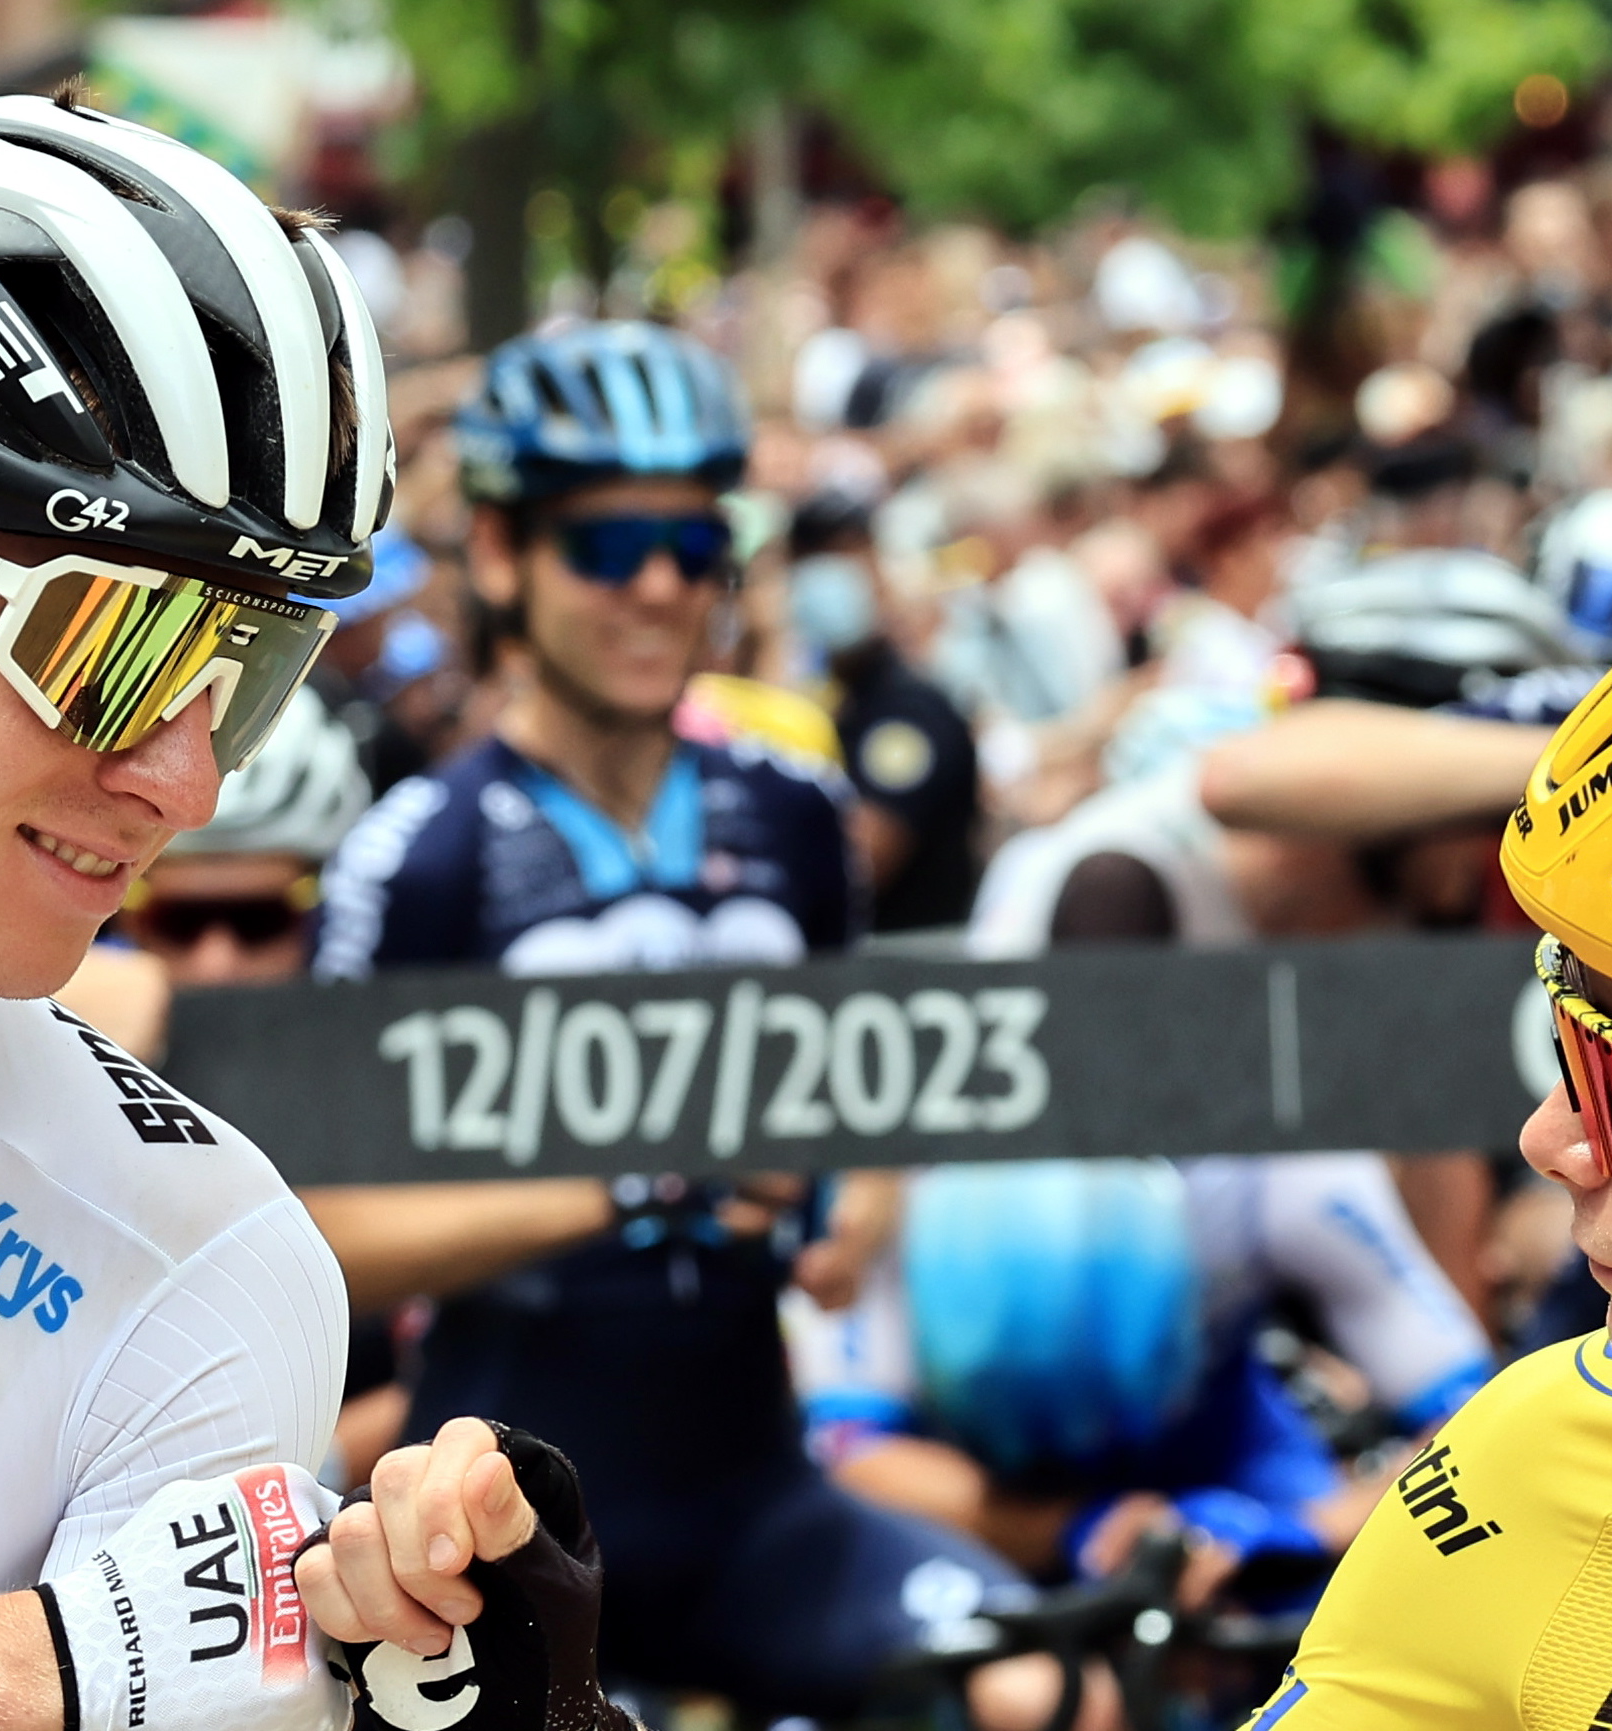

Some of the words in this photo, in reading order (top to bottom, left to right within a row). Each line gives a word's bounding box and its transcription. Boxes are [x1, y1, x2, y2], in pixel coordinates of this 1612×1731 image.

[45, 488, 132, 532] G42
[228, 535, 349, 581] MET
[204, 586, 307, 619] SCICONSPORTS
[380, 980, 1050, 1164] 12/07/2023
[1398, 1440, 1503, 1557] tini
[92, 1550, 125, 1593] MILLE
[168, 1501, 251, 1664] UAE
[255, 1479, 301, 1648] Emirates
[114, 1596, 147, 1728] RICHARD
